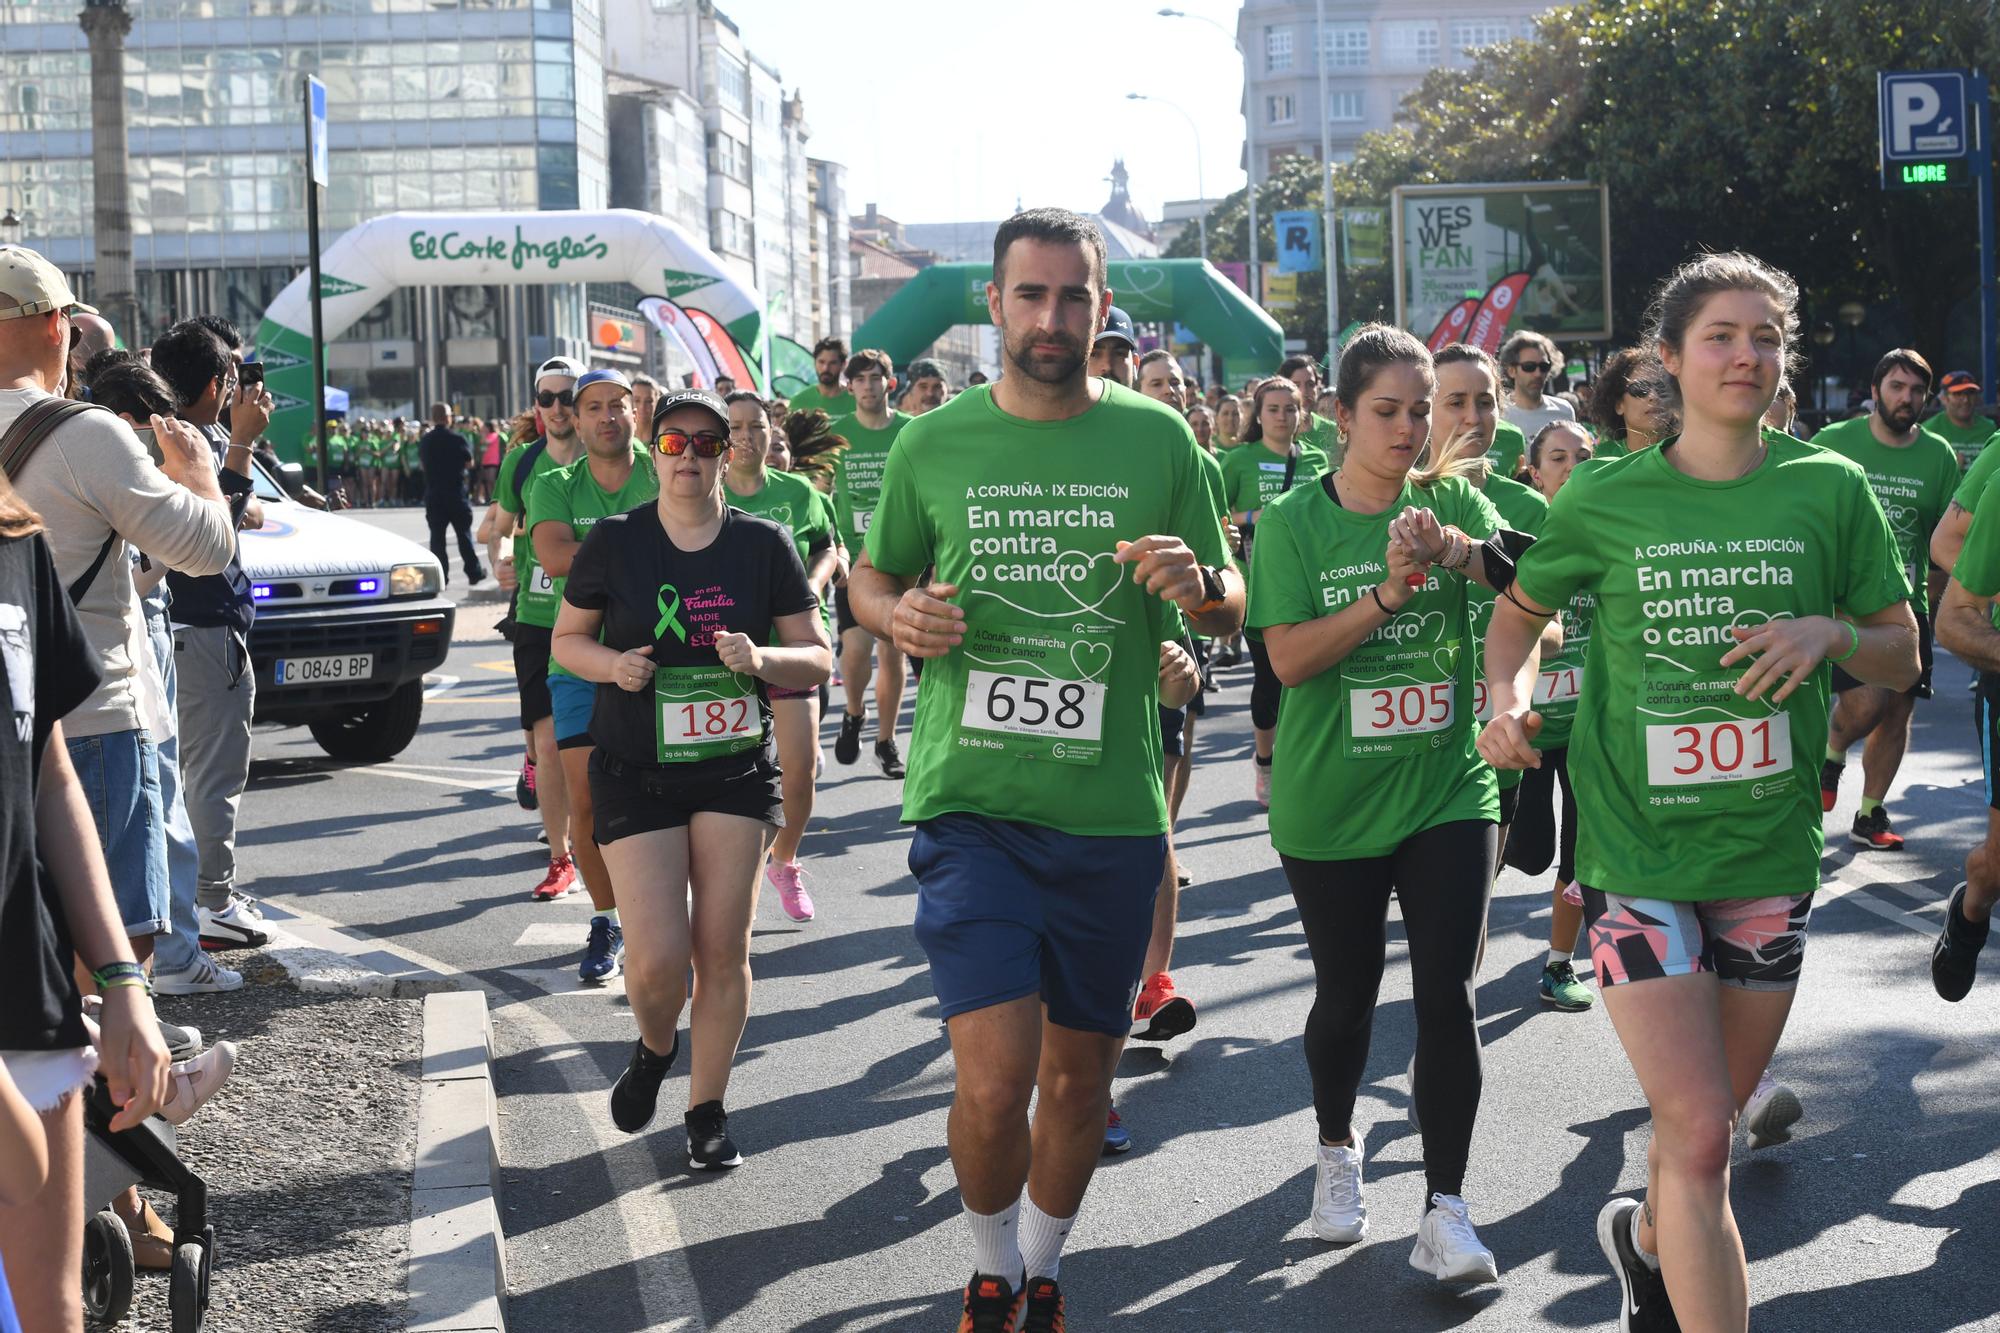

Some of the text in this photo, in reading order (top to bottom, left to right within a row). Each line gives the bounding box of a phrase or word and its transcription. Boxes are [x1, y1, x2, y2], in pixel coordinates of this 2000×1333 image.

[1892, 82, 1941, 152] P
[1903, 164, 1946, 182] LIBRE
[1418, 206, 1472, 229] YES
[1418, 225, 1462, 248] WE
[409, 225, 608, 270] El Corte Inglés
[1419, 246, 1473, 268] FAN
[666, 393, 721, 409] adidas
[845, 461, 857, 470] En
[846, 471, 878, 480] contra
[966, 487, 975, 499] A
[1052, 484, 1066, 497] IX
[1070, 483, 1129, 498] EDICIÓN
[1259, 482, 1273, 491] En
[1872, 484, 1917, 498] marcha
[1260, 493, 1282, 502] con
[967, 504, 1115, 528] En marcha
[970, 532, 1057, 556] contra
[1635, 547, 1644, 560] A
[1726, 541, 1742, 553] IX
[1745, 537, 1805, 554] EDICIÓN
[971, 563, 1087, 582] o cancro
[1320, 572, 1328, 582] A
[1637, 560, 1793, 591] En marcha
[695, 585, 721, 595] en esta
[1322, 587, 1350, 607] En
[683, 595, 735, 610] Familia
[1642, 592, 1735, 619] contra
[690, 613, 720, 622] NADIE
[701, 622, 727, 632] lucha
[1643, 624, 1750, 646] o canc
[973, 641, 1046, 659] contra o cancro
[1013, 635, 1026, 644] en
[1028, 636, 1066, 649] marcha
[1397, 650, 1429, 660] marcha
[285, 657, 369, 681] C 0849 BP
[704, 671, 732, 680] marcha
[1349, 665, 1377, 673] contra
[1386, 662, 1415, 671] cancro
[694, 680, 719, 689] cancro
[1542, 669, 1580, 699] 71
[1656, 681, 1691, 691] Coruña
[1693, 682, 1706, 691] en
[1709, 679, 1740, 689] marc
[987, 676, 1085, 729] 658
[1371, 684, 1450, 729] 305
[1646, 693, 1731, 704] contra o cancro
[680, 699, 749, 737] 182
[958, 737, 1004, 750] 29 de Maio
[1374, 743, 1393, 752] Maio
[1673, 720, 1777, 775] 301
[1649, 795, 1700, 806] 29 de Maio
